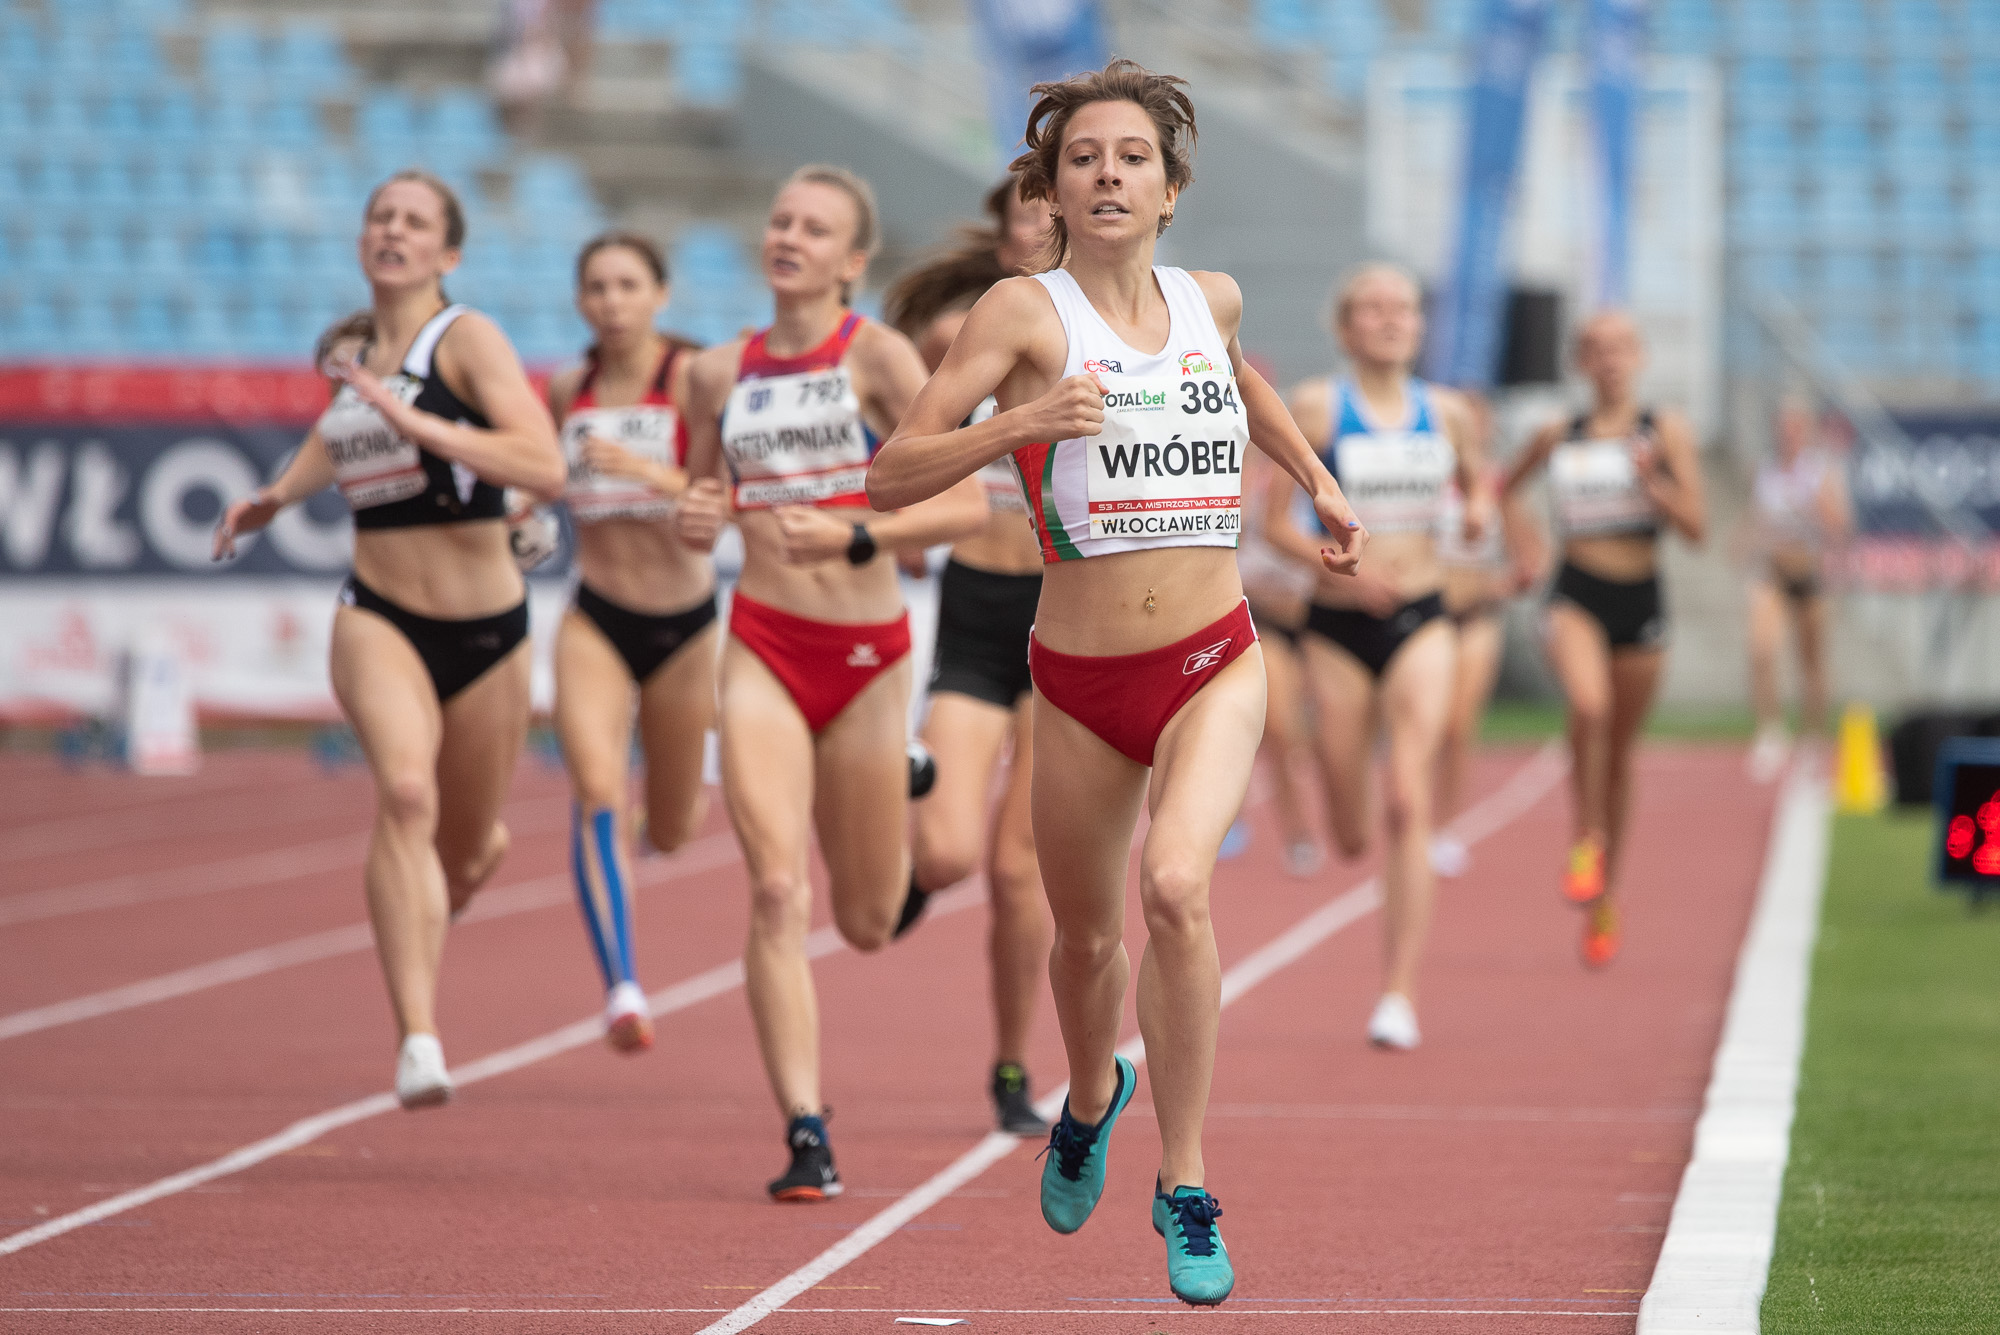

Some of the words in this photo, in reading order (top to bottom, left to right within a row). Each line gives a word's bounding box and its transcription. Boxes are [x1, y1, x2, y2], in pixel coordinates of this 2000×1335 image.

[1180, 380, 1239, 414] 384
[1098, 433, 1240, 479] WRÓBEL
[1098, 503, 1115, 511] 53.
[1117, 502, 1143, 510] PZLA
[1146, 500, 1208, 509] MISTRZOSTWA
[1209, 498, 1232, 507] POLSKI
[1101, 514, 1212, 534] WŁOCŁAWEK
[1215, 513, 1239, 530] 2021
